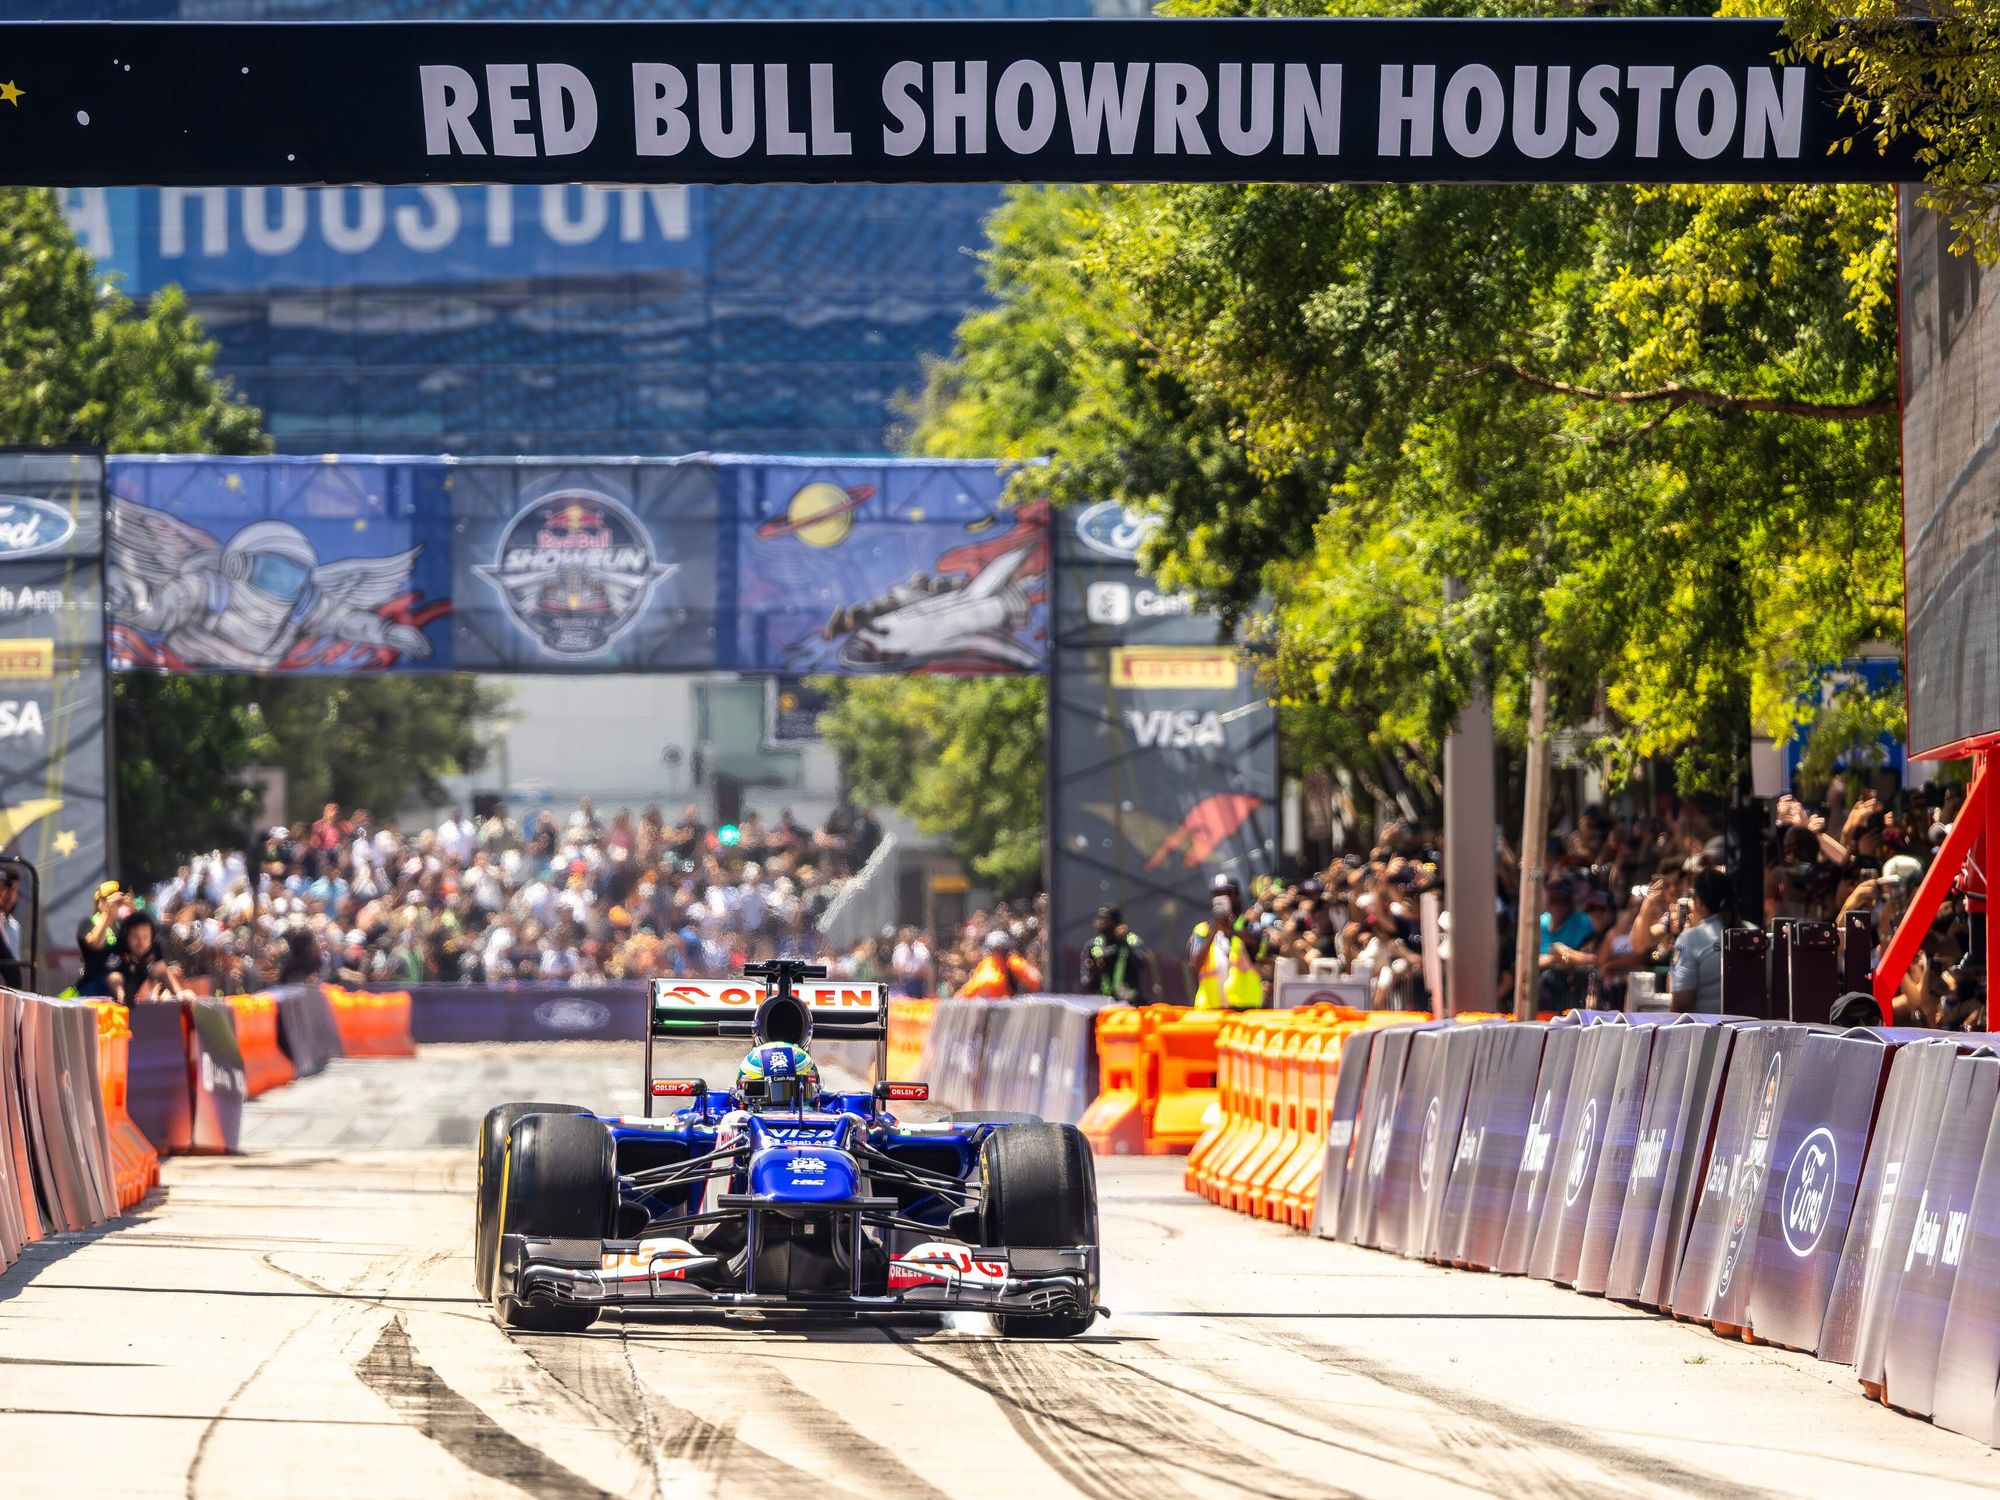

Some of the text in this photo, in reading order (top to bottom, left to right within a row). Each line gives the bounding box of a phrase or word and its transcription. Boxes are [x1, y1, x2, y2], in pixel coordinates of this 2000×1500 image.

[420, 60, 1805, 159] RED BULL SHOWRUN HOUSTON
[1124, 710, 1225, 747] VISA
[767, 1128, 835, 1139] VISA
[1789, 1144, 1831, 1235] Ford
[1941, 1210, 1968, 1266] VISA
